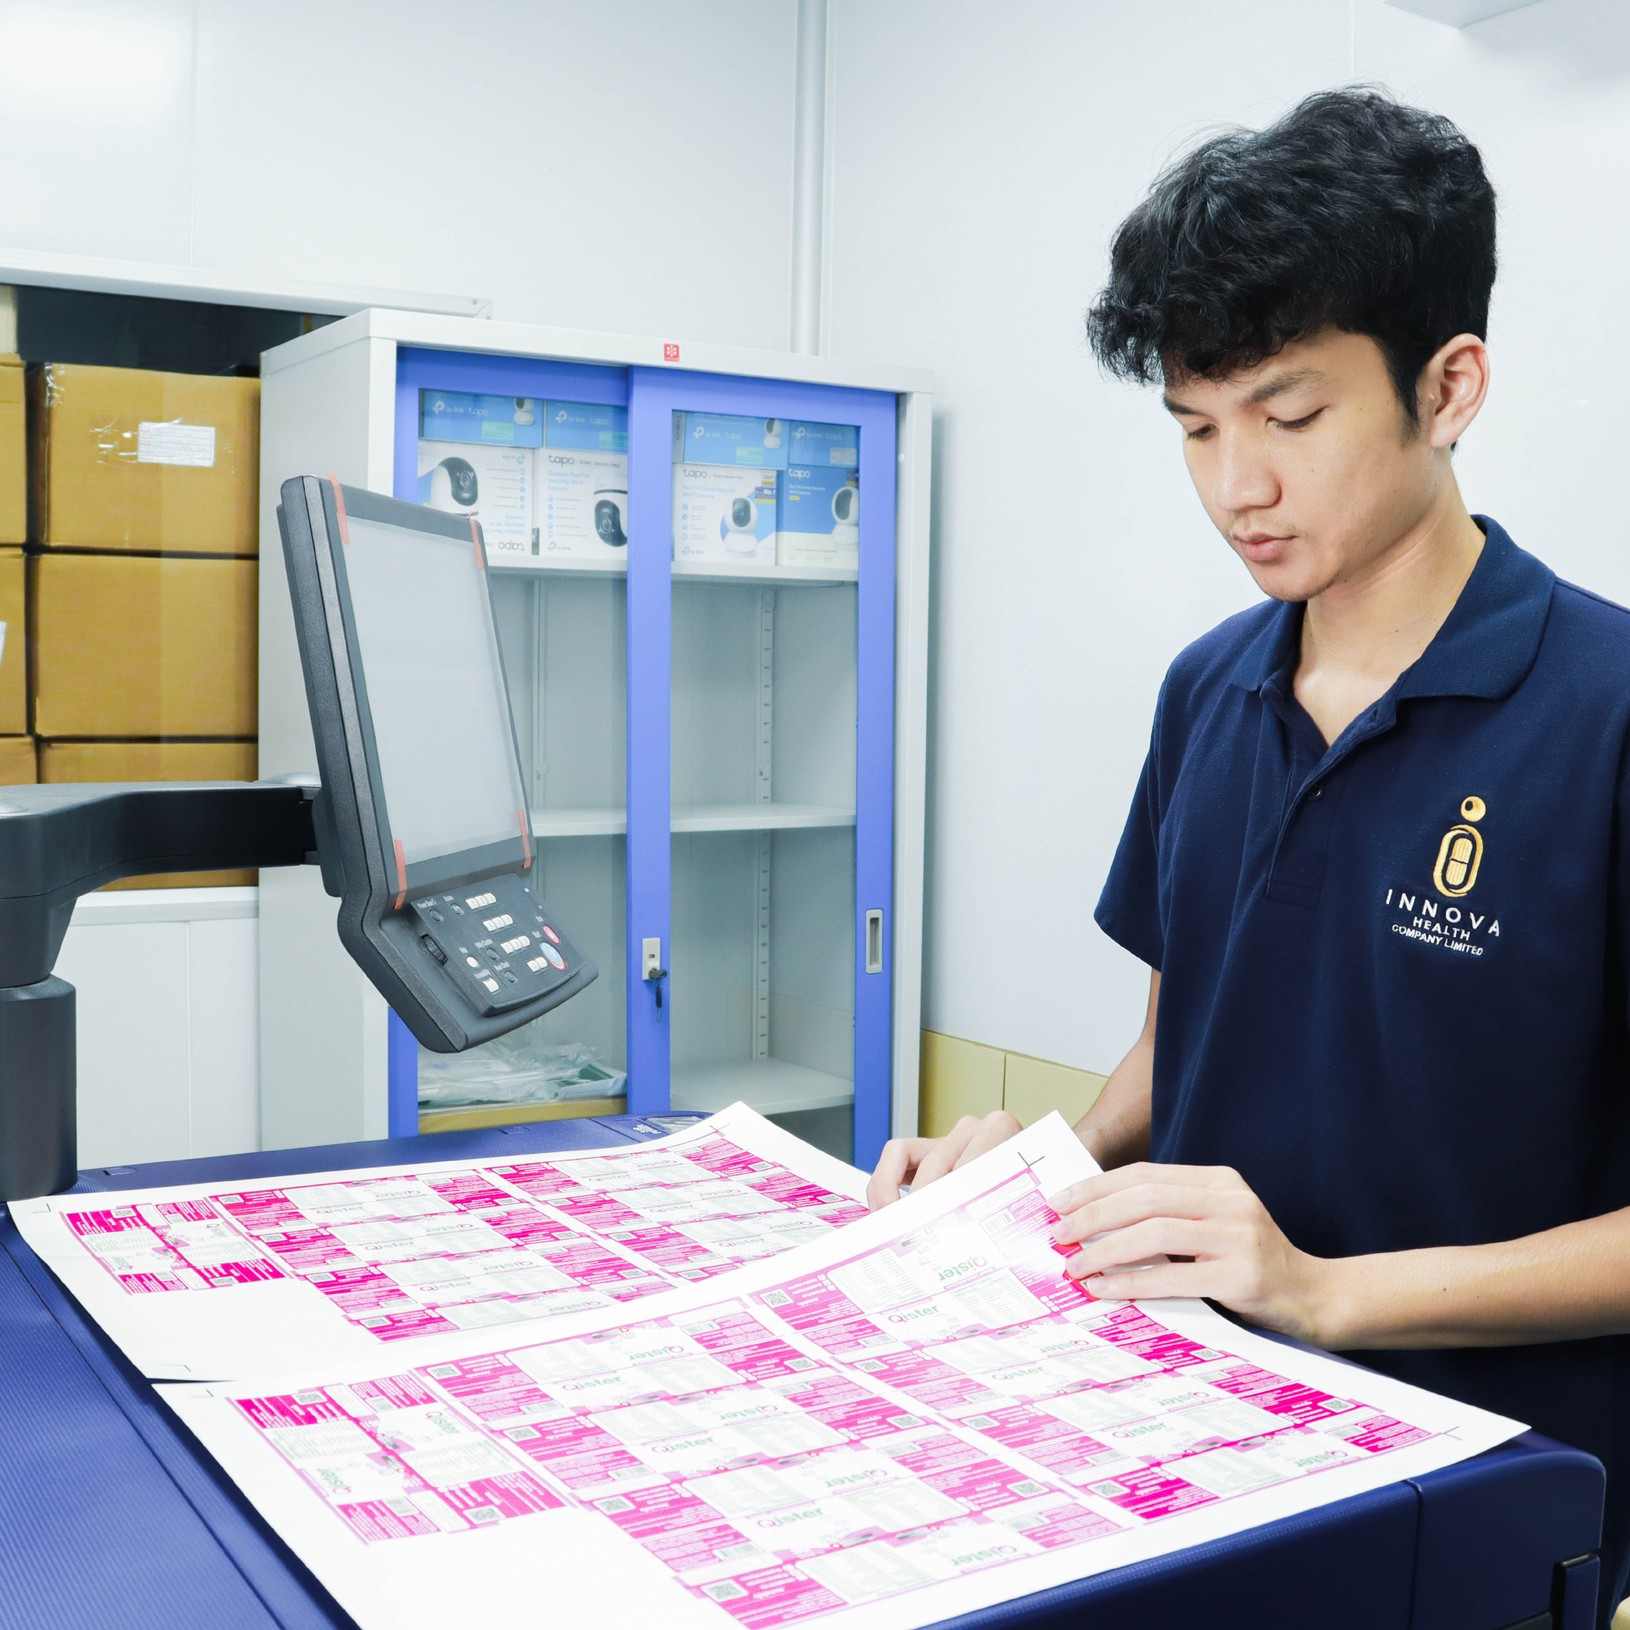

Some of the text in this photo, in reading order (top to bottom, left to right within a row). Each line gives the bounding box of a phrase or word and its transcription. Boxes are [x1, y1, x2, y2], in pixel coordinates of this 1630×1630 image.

[468, 408, 489, 416] tapo
[548, 454, 576, 468] tapo
[682, 468, 708, 480] tapo
[788, 468, 811, 480] tapo
[1386, 888, 1500, 936] INNOVA
[1413, 916, 1470, 941] HEALTH
[1392, 924, 1484, 956] COMPANY LIMITED
[938, 1256, 987, 1282] Qister
[888, 1304, 939, 1323] Qister
[992, 1366, 1045, 1381] Qister
[562, 1376, 621, 1391] Qister
[1112, 1422, 1167, 1439] Qister
[652, 1436, 714, 1453] Qister
[758, 1508, 823, 1528] Qister
